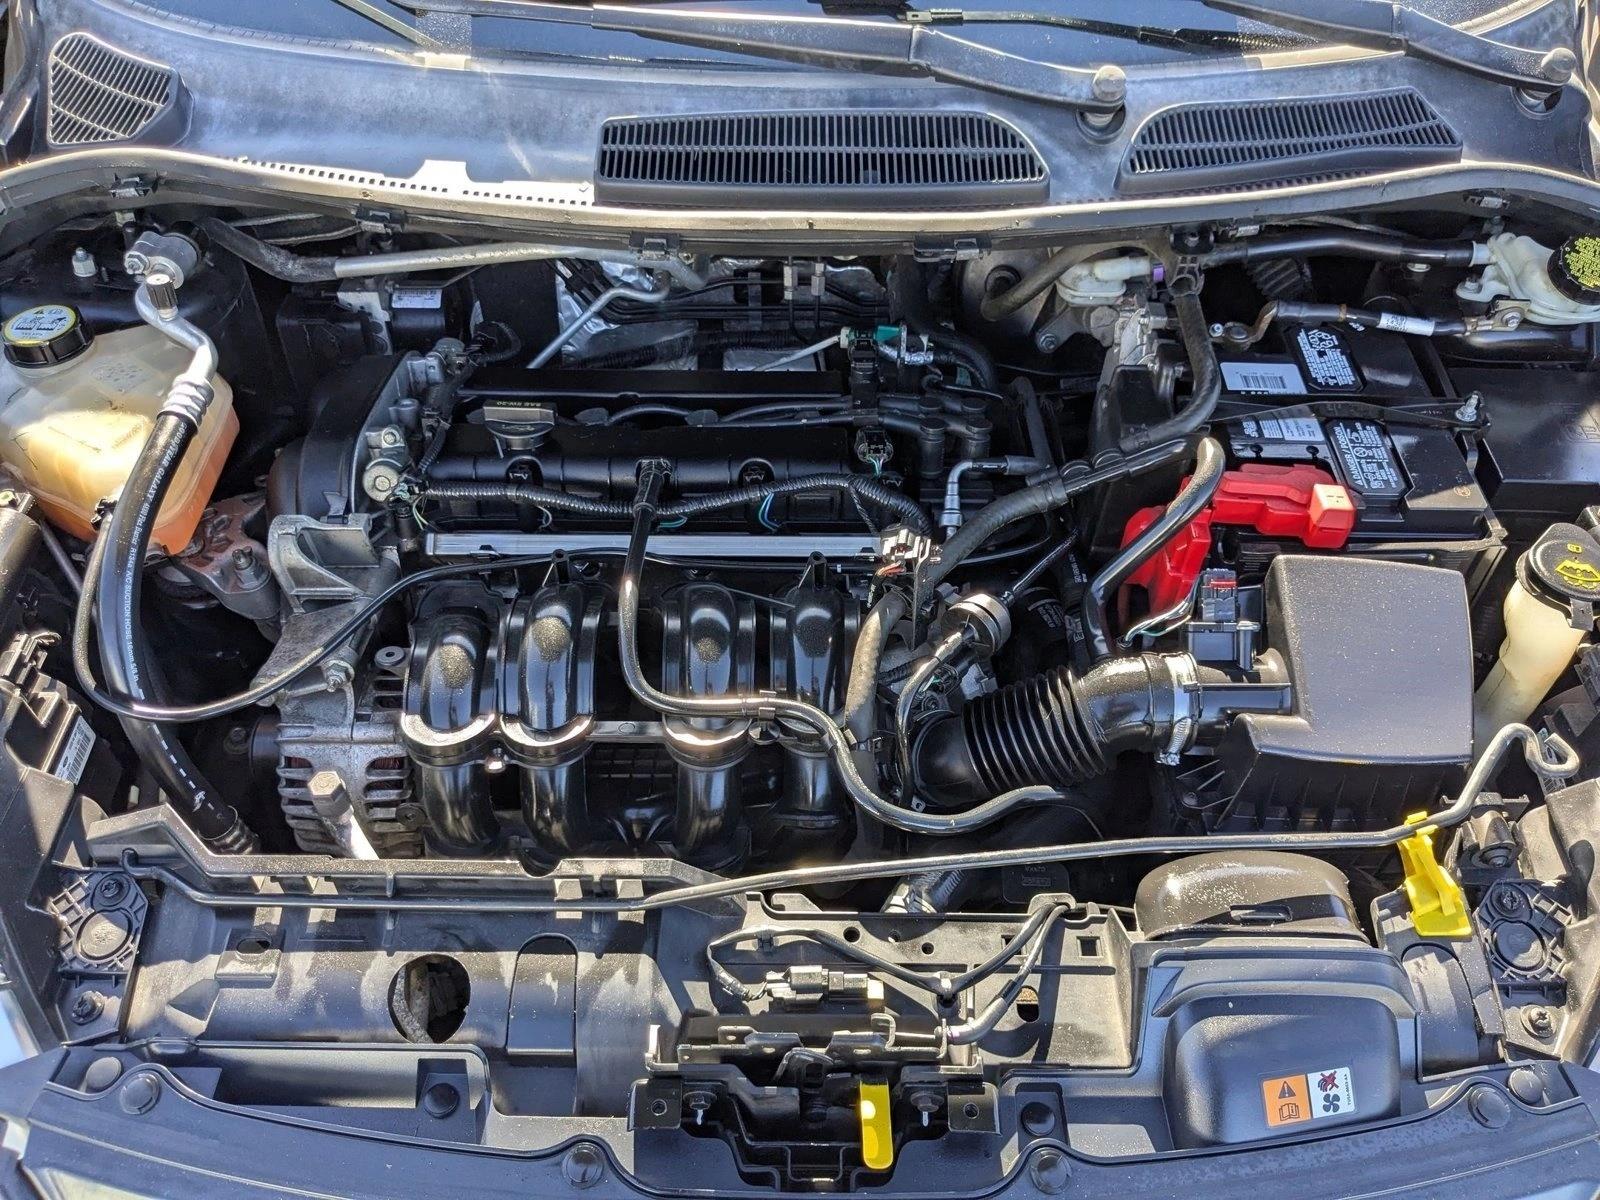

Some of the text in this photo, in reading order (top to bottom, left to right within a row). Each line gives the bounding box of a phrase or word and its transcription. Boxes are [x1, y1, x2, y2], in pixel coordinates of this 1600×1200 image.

[162, 421, 188, 467] GOODYEAR
[1333, 426, 1349, 449] POISON
[1344, 453, 1361, 480] DANGER
[146, 468, 165, 502] GALAXY
[136, 514, 147, 527] Flex
[131, 526, 143, 546] Barrier
[127, 547, 137, 568] R134a
[124, 584, 132, 617] SUCTION
[125, 620, 133, 640] HOSE
